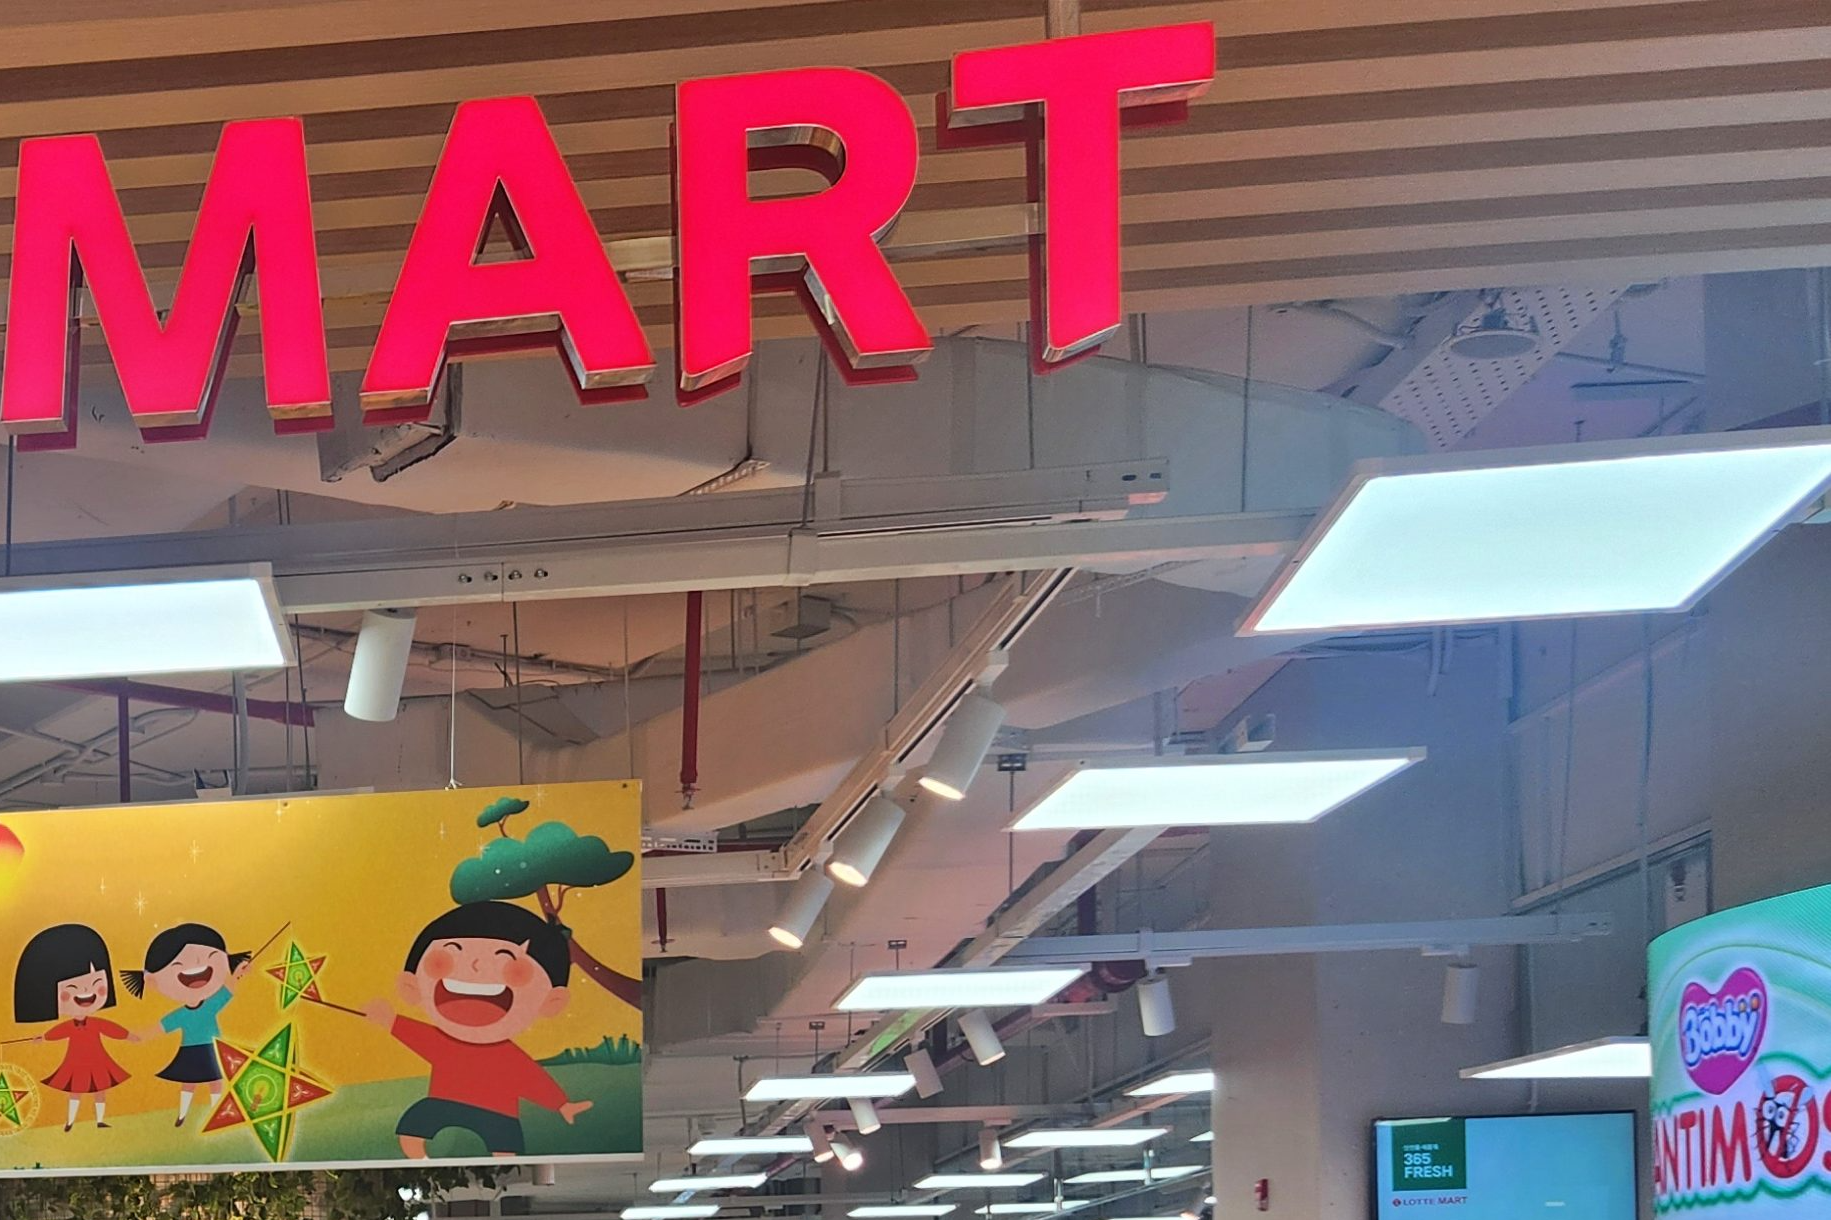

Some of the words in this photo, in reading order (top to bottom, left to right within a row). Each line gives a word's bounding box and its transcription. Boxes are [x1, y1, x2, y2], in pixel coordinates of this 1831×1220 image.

[1, 20, 1216, 432] MART
[1403, 1152, 1431, 1166] 365
[1404, 1165, 1454, 1178] FRESH
[1403, 1198, 1435, 1206] LOTTE
[1437, 1195, 1467, 1204] MART
